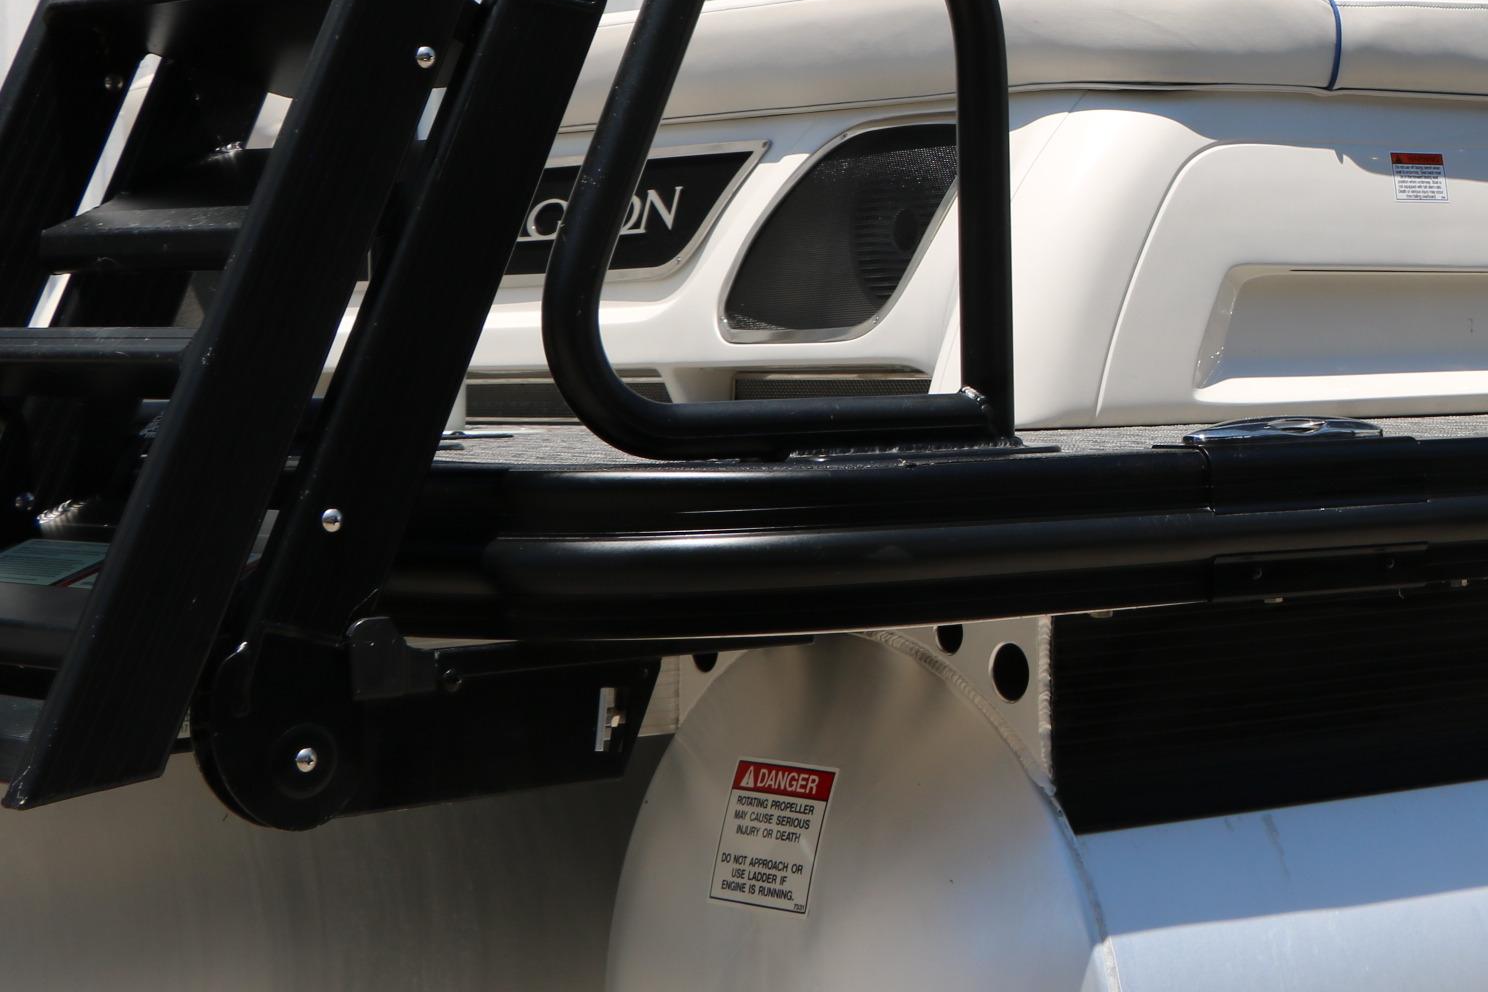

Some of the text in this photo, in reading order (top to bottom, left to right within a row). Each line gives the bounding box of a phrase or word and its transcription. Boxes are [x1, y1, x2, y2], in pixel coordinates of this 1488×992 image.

[757, 768, 820, 795] DANGER
[736, 795, 815, 815] ROTATING PROPELLER
[733, 809, 811, 830] MAY CAUSE SERIOUS
[735, 824, 801, 844] INJURY OR DEATH
[721, 852, 804, 875] DO NOT APPROACH OR
[731, 868, 788, 886] USE LADDER IF
[721, 879, 795, 901] ENGINE IS RUNNING.
